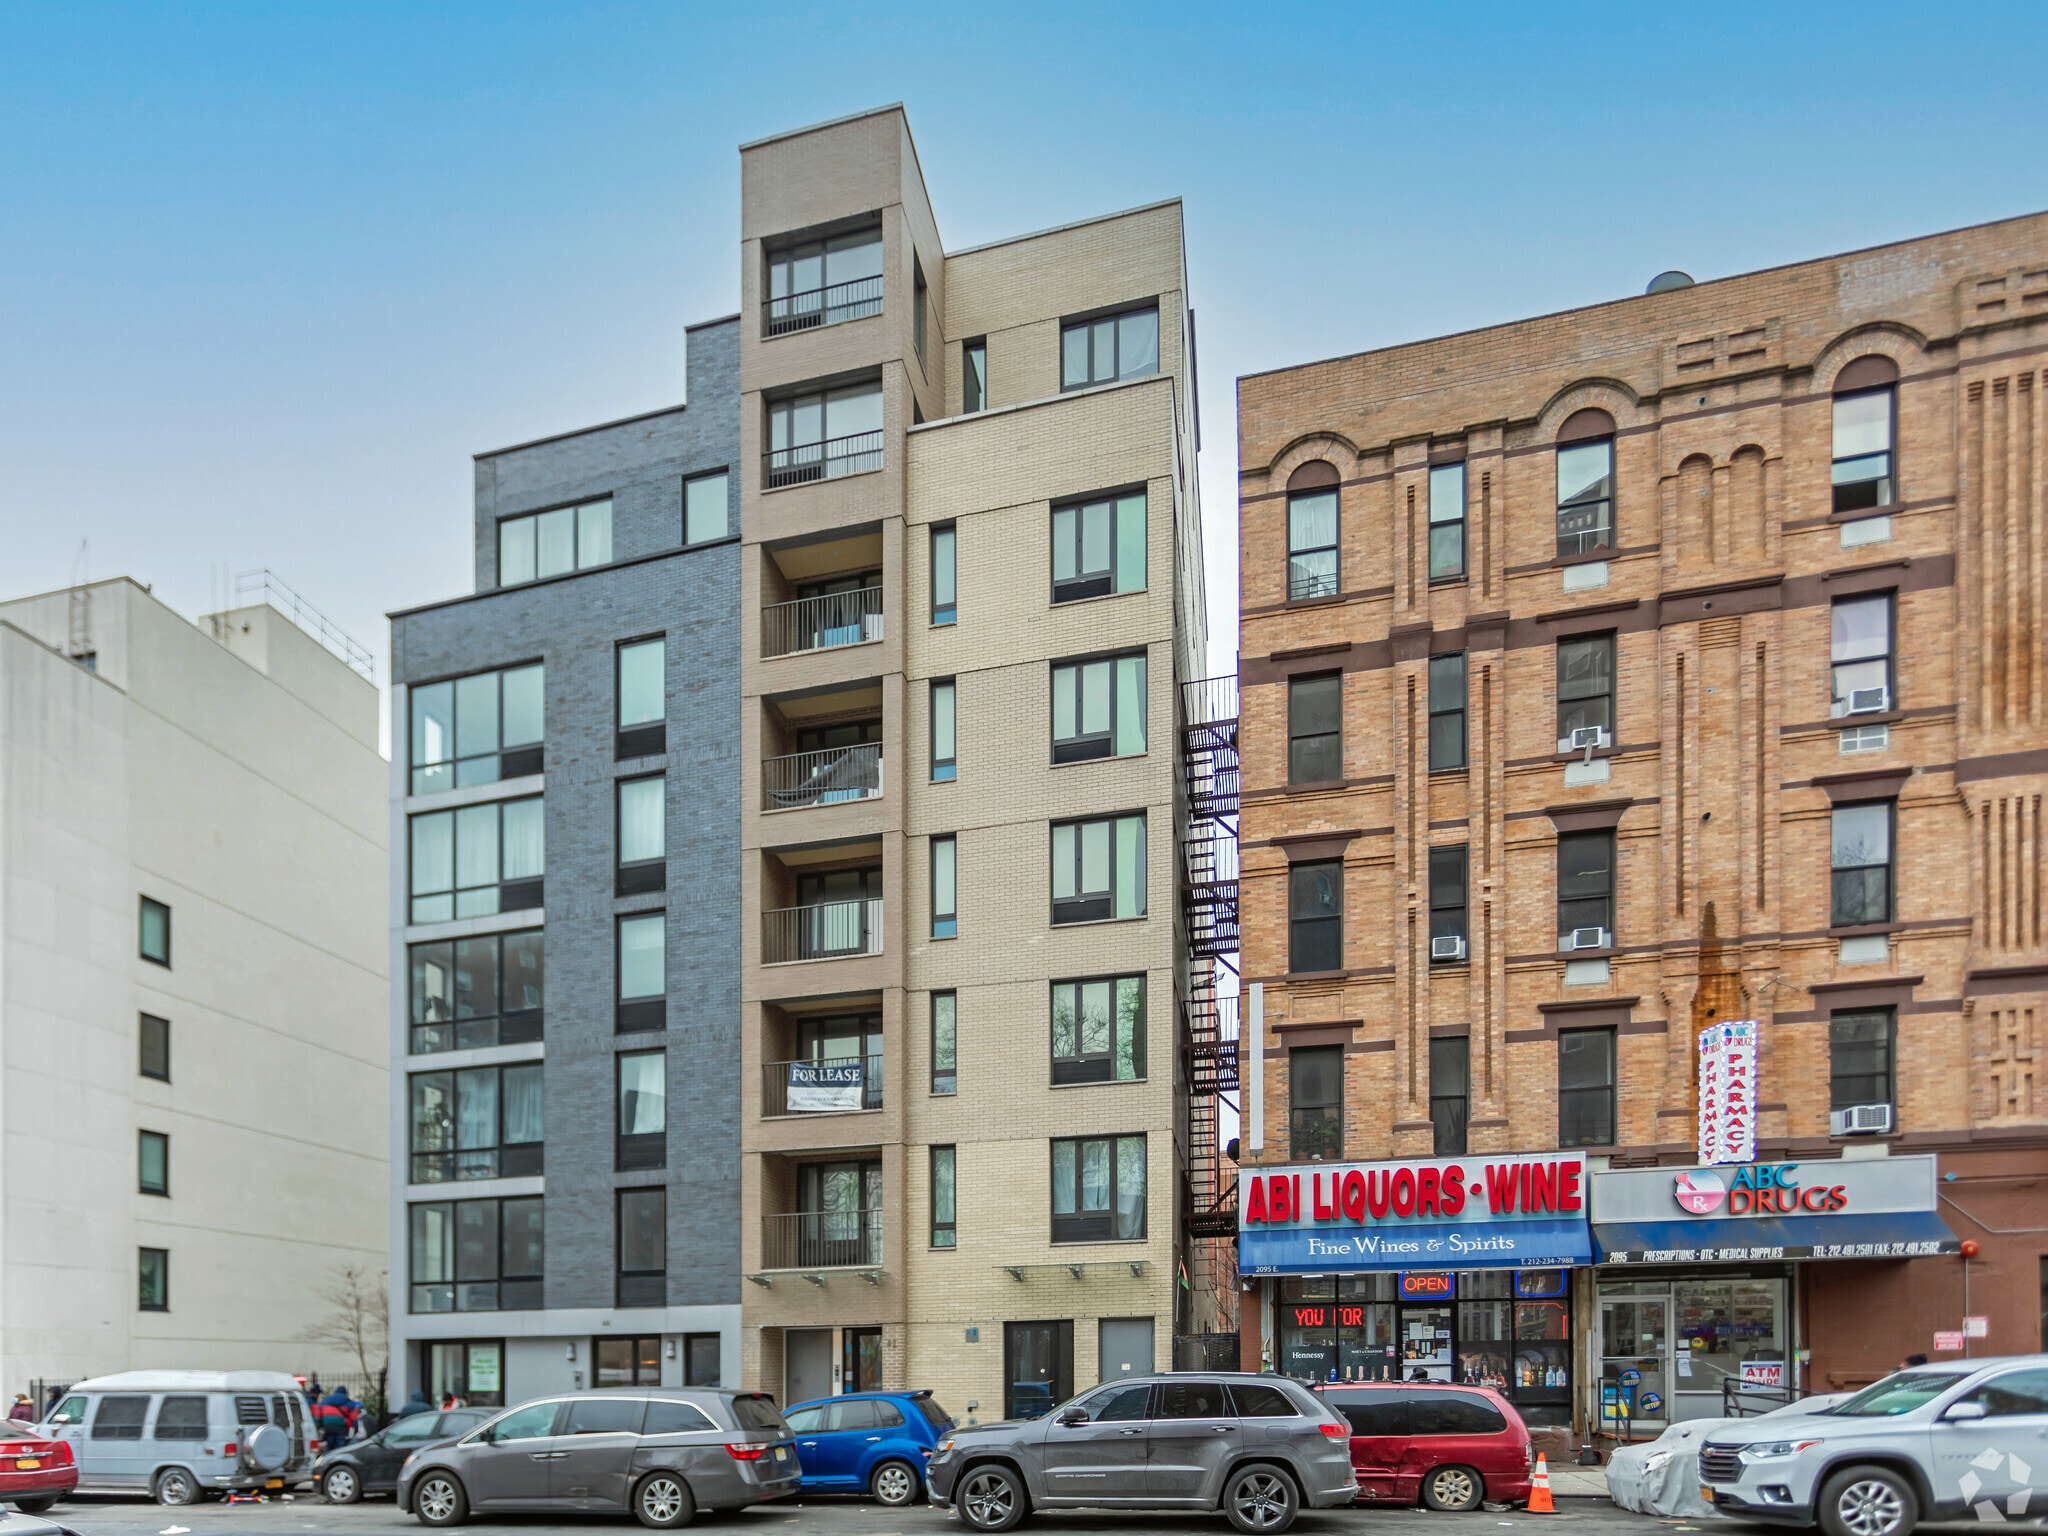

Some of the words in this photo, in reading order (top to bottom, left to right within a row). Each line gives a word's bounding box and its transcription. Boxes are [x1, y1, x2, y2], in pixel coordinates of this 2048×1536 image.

[792, 1069, 818, 1082] FOR
[820, 1069, 861, 1082] LEASE
[1704, 1060, 1718, 1160] PHARMACY
[1725, 1053, 1748, 1154] PHARMACY
[1731, 1163, 1799, 1190] ABC
[1246, 1174, 1300, 1224] ABI
[1313, 1165, 1466, 1226] LIQUORS
[1485, 1161, 1582, 1213] WINE
[1729, 1185, 1848, 1214] DRUGS
[1308, 1238, 1351, 1256] Fine
[1353, 1236, 1419, 1255] Wines
[1426, 1239, 1445, 1252] &
[1449, 1233, 1515, 1255] Spirits
[1828, 1244, 1873, 1257] 212.491.2501
[1891, 1241, 1940, 1254] 212.491.2502
[1527, 1257, 1574, 1265] 212-234-7988
[1609, 1252, 1628, 1263] 2095
[1643, 1250, 1695, 1262] PRESCRIPTIONS
[1700, 1249, 1714, 1260] OTC
[1718, 1247, 1748, 1260] MEDICAL
[1750, 1247, 1783, 1259] SUPPLIES
[1404, 1277, 1449, 1291] OPEN
[1294, 1308, 1325, 1326] YOU
[1292, 1351, 1325, 1360] Hennessy
[1745, 1367, 1780, 1377] ATM
